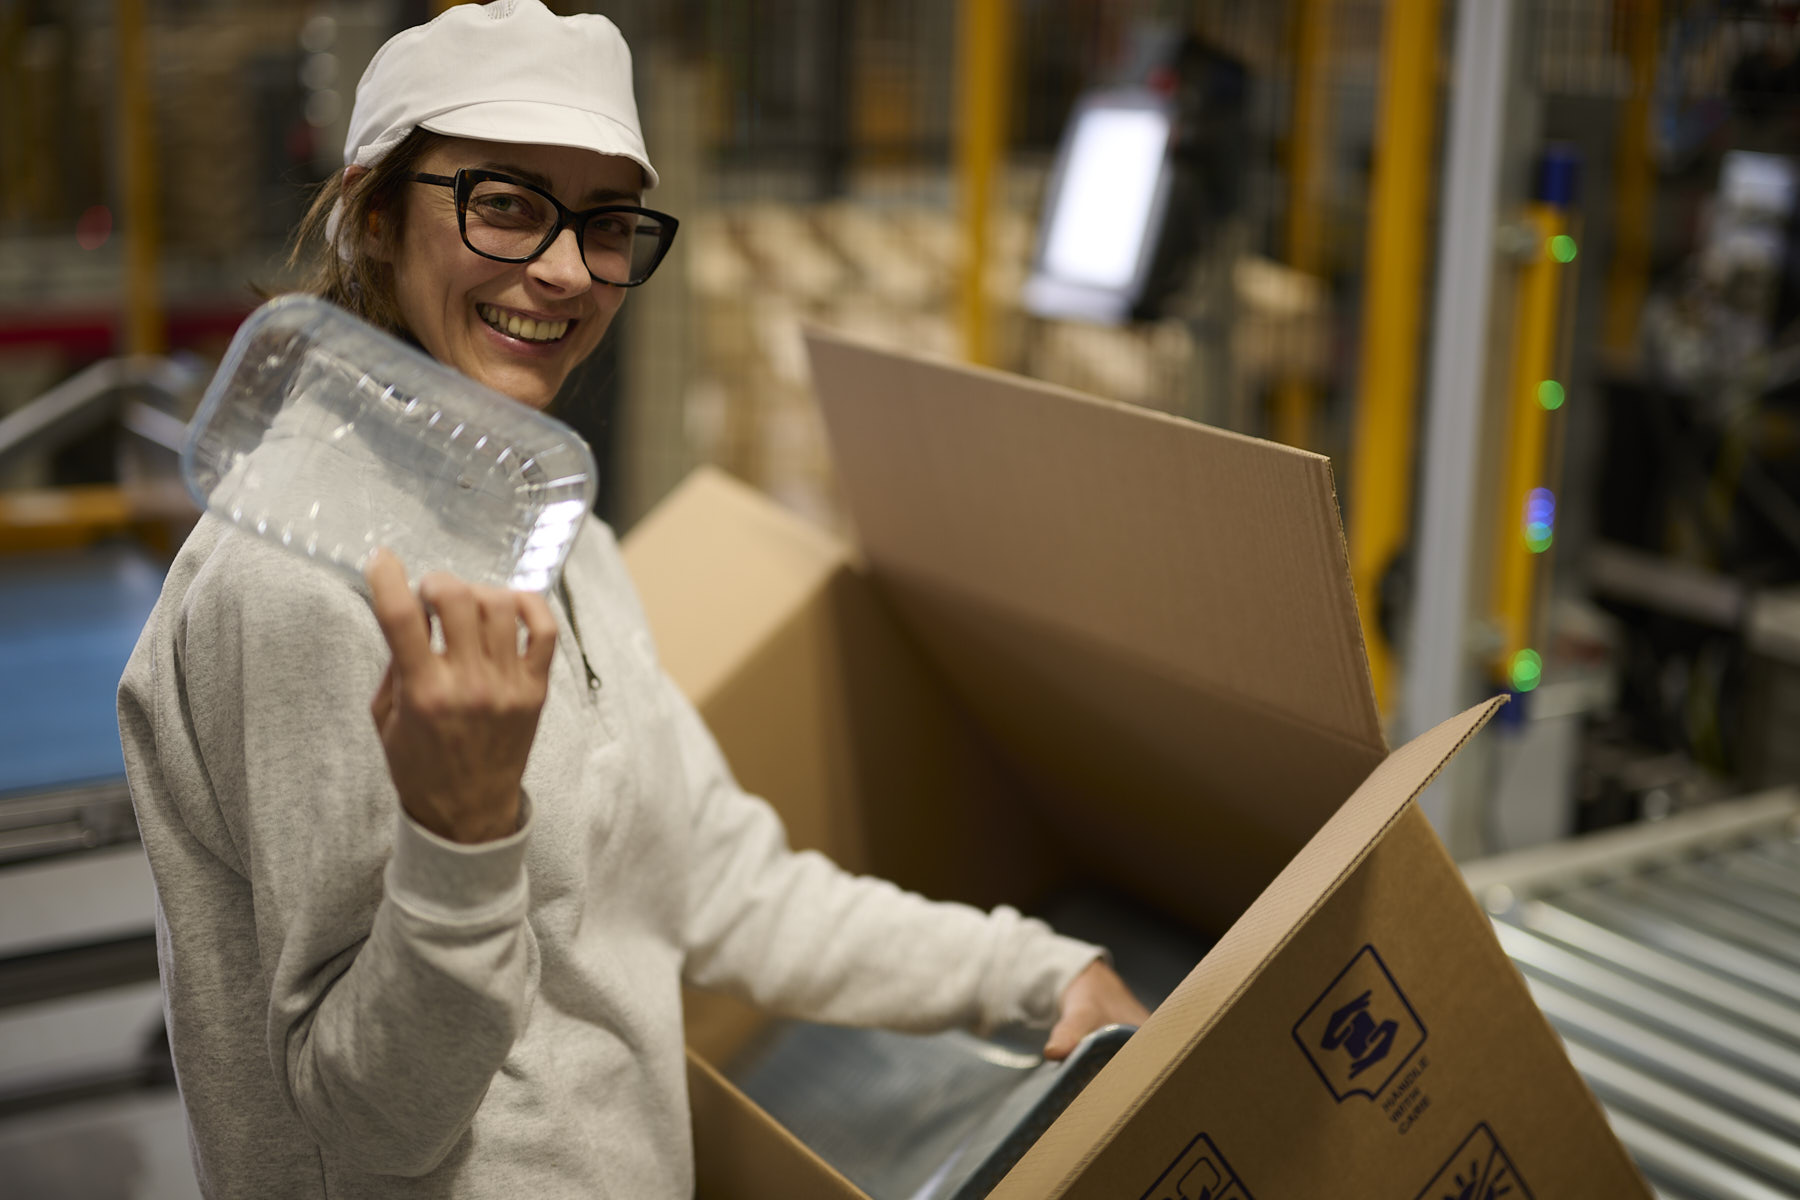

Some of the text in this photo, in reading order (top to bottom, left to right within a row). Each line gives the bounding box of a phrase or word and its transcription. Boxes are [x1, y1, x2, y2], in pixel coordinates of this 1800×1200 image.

[1382, 1056, 1429, 1112] HANDLE
[1390, 1087, 1420, 1122] WITH
[1398, 1096, 1431, 1134] CARE
